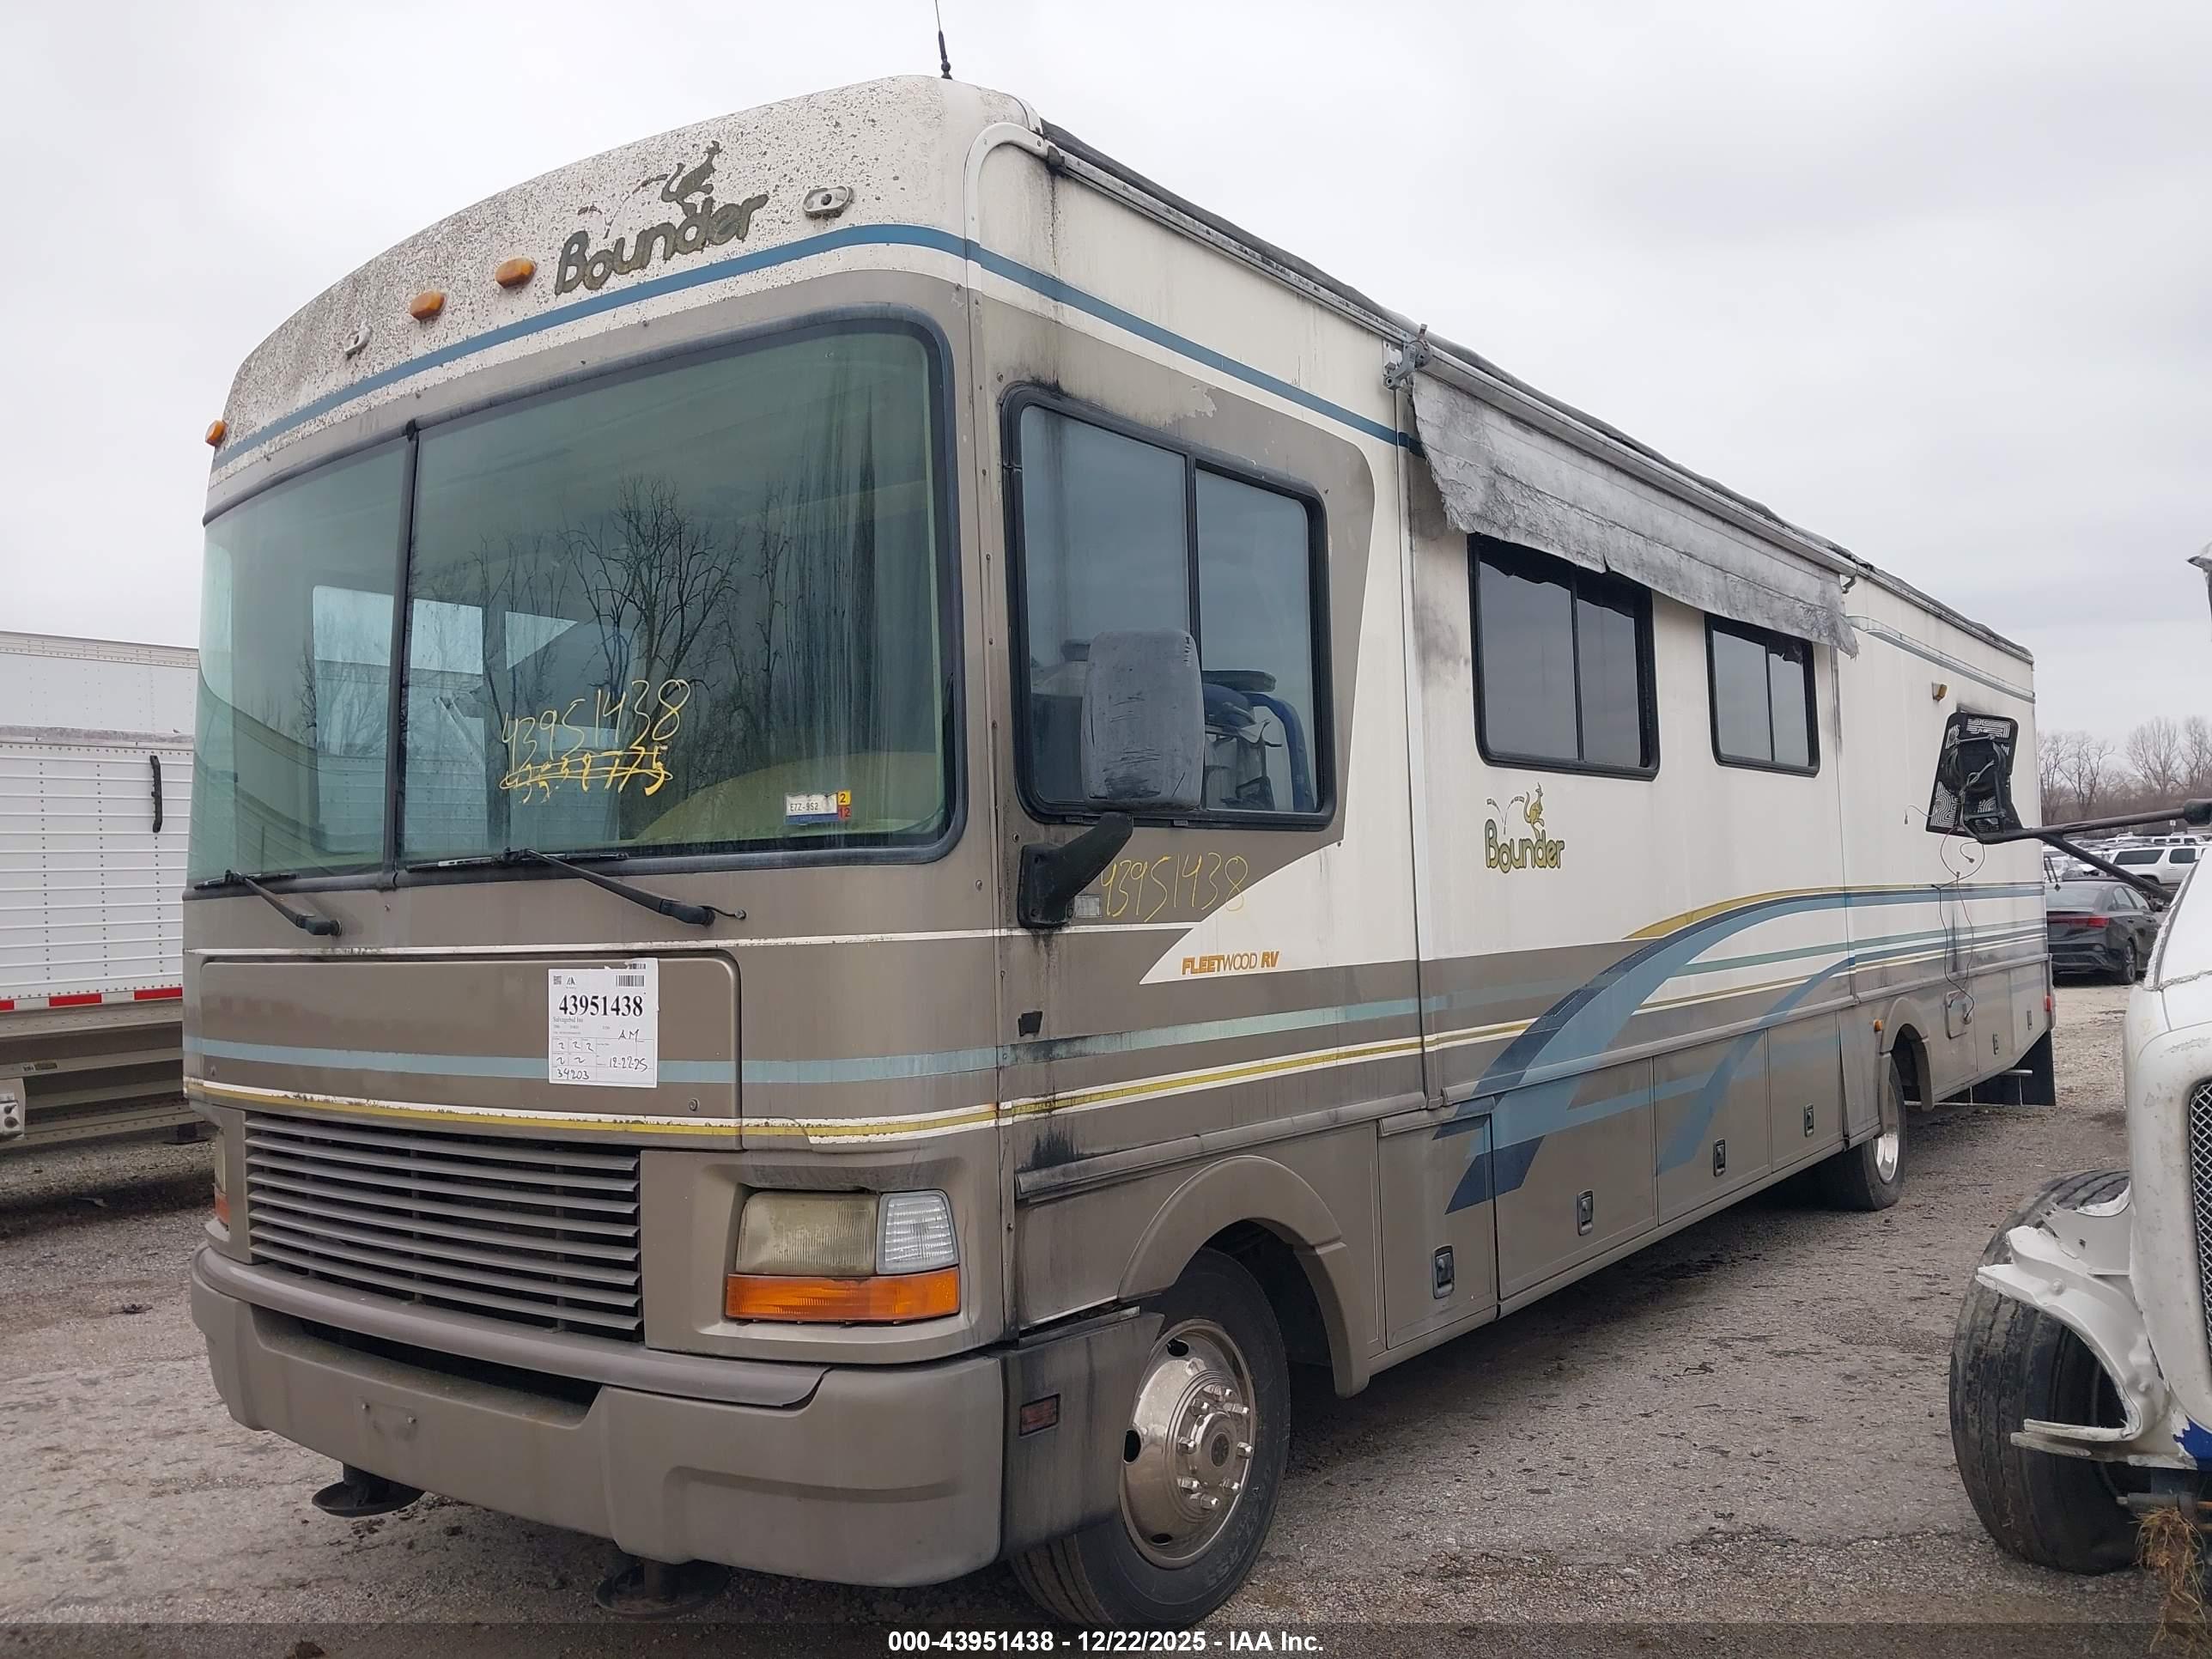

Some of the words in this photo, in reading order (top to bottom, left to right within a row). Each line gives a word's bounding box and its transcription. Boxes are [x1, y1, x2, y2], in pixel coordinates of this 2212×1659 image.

[555, 194, 769, 296] Bounder
[501, 679, 690, 772] 43951438
[840, 793, 846, 803] 2
[1485, 819, 1565, 873] Bounder
[1100, 852, 1249, 922] 43951438
[1182, 952, 1257, 975] FLEETWOOD
[1261, 951, 1279, 969] RV
[559, 994, 643, 1017] 43951438
